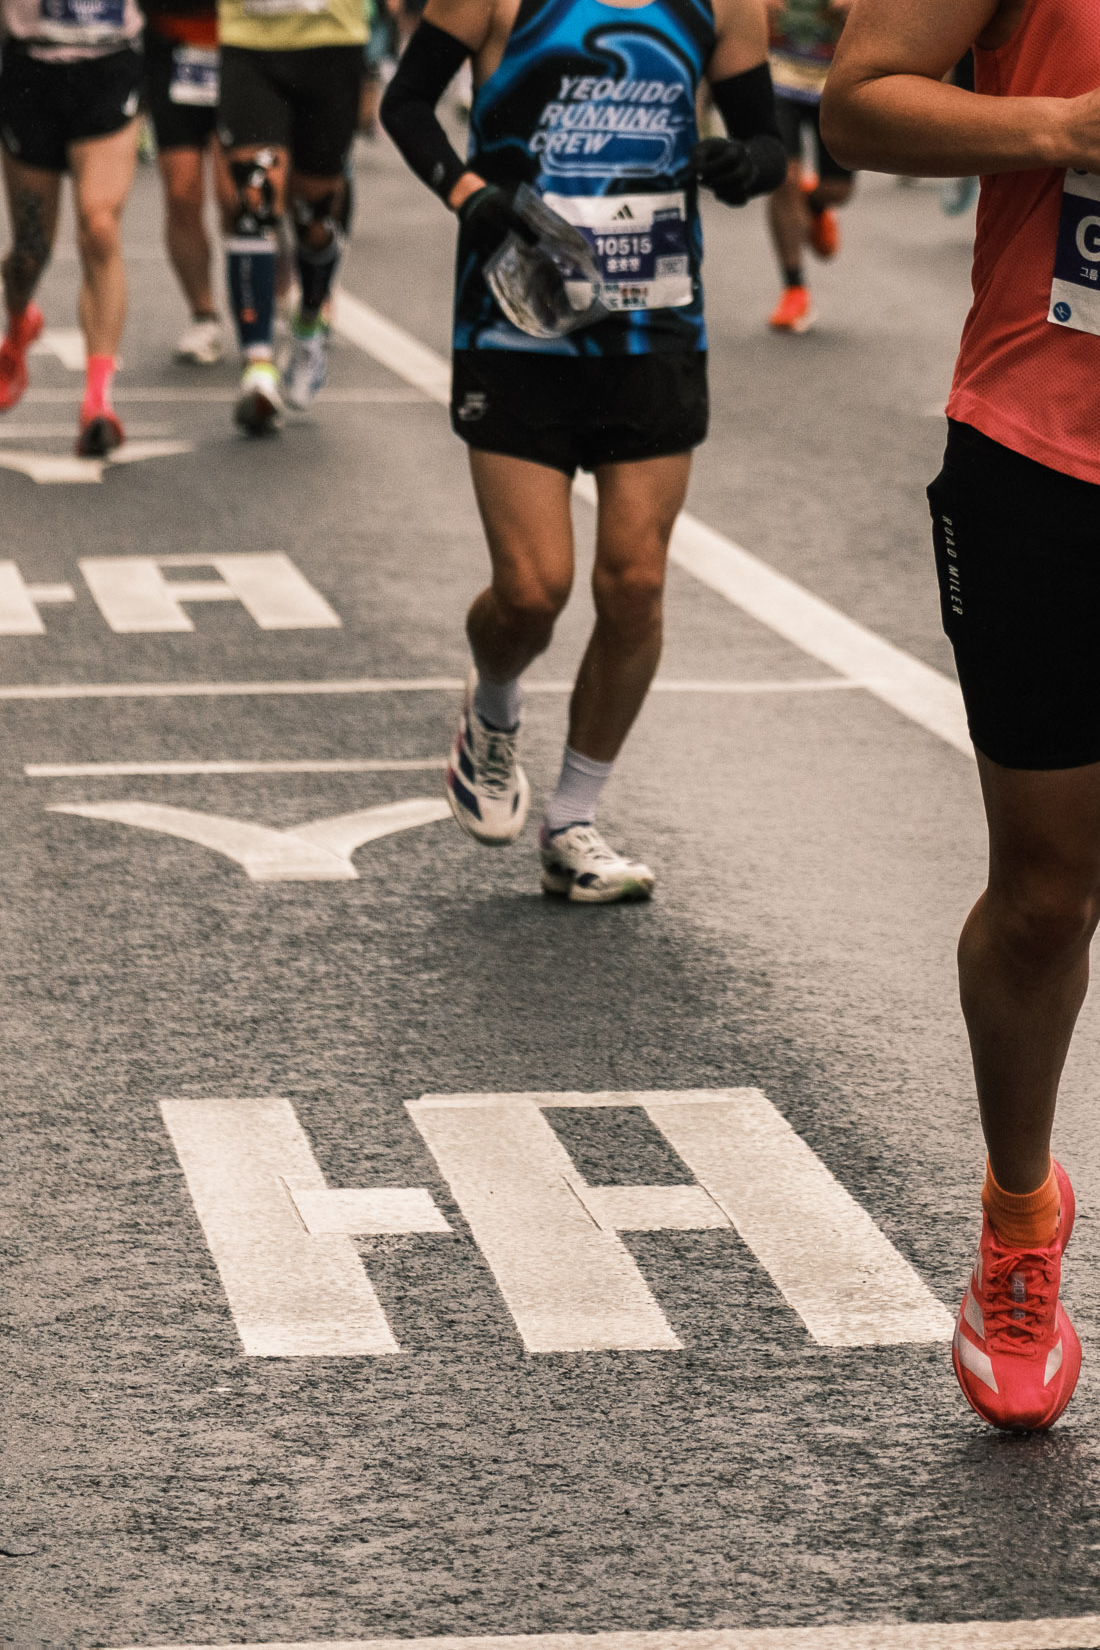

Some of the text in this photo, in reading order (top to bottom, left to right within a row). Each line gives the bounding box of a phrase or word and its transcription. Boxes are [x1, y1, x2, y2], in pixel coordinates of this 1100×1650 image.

[558, 75, 685, 104] YEOUIDO
[538, 102, 673, 131] RUNNING
[527, 130, 613, 155] CREW
[595, 236, 652, 256] 10515
[1079, 266, 1100, 281] 그룹
[942, 515, 964, 615] ROAD MILER
